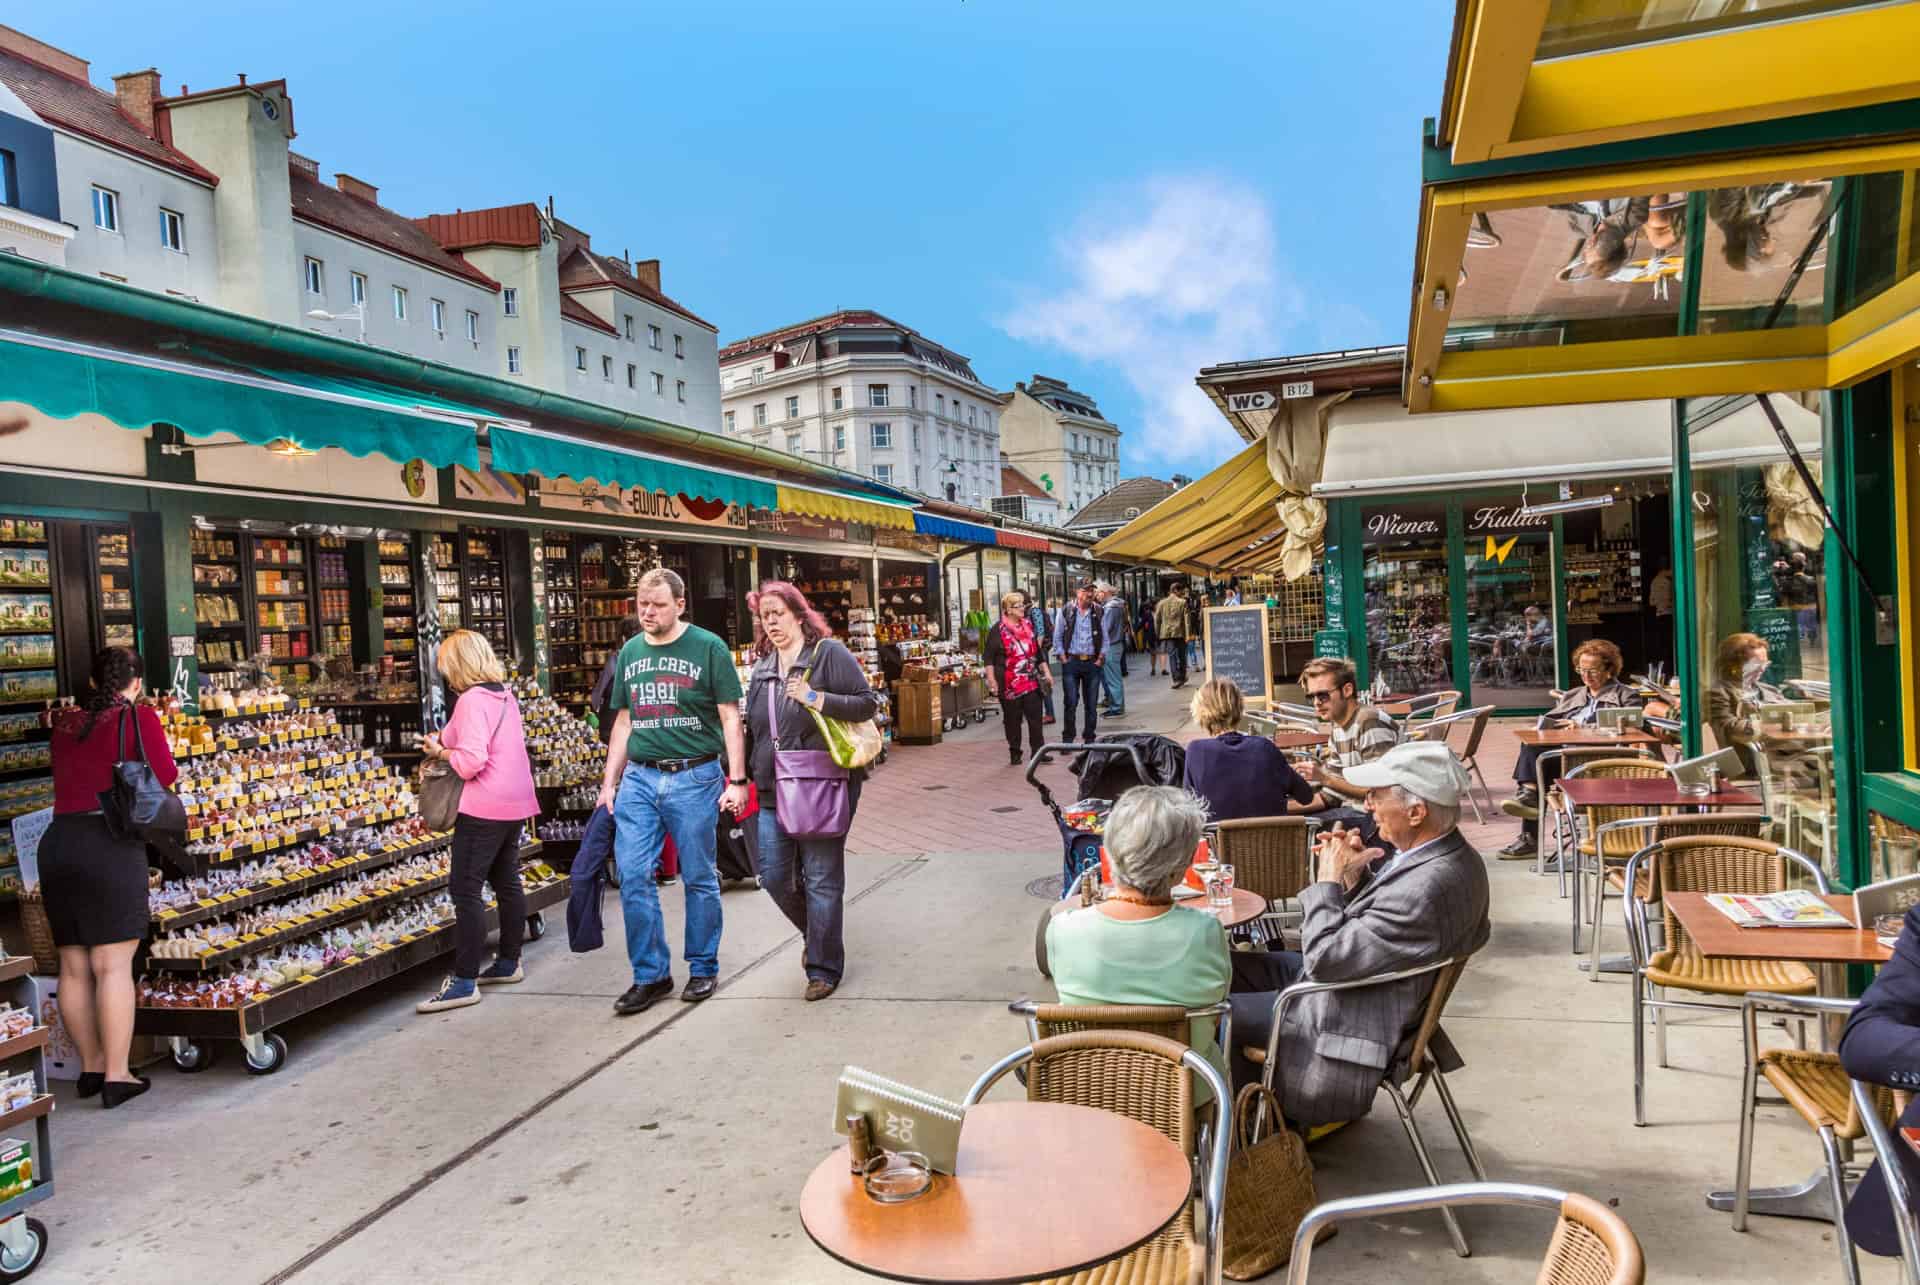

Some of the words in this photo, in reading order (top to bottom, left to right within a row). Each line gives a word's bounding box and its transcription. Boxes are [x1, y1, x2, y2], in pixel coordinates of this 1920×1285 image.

[1233, 394, 1265, 410] WC
[624, 656, 703, 681] ATHL.CREW
[639, 682, 676, 700] 1981
